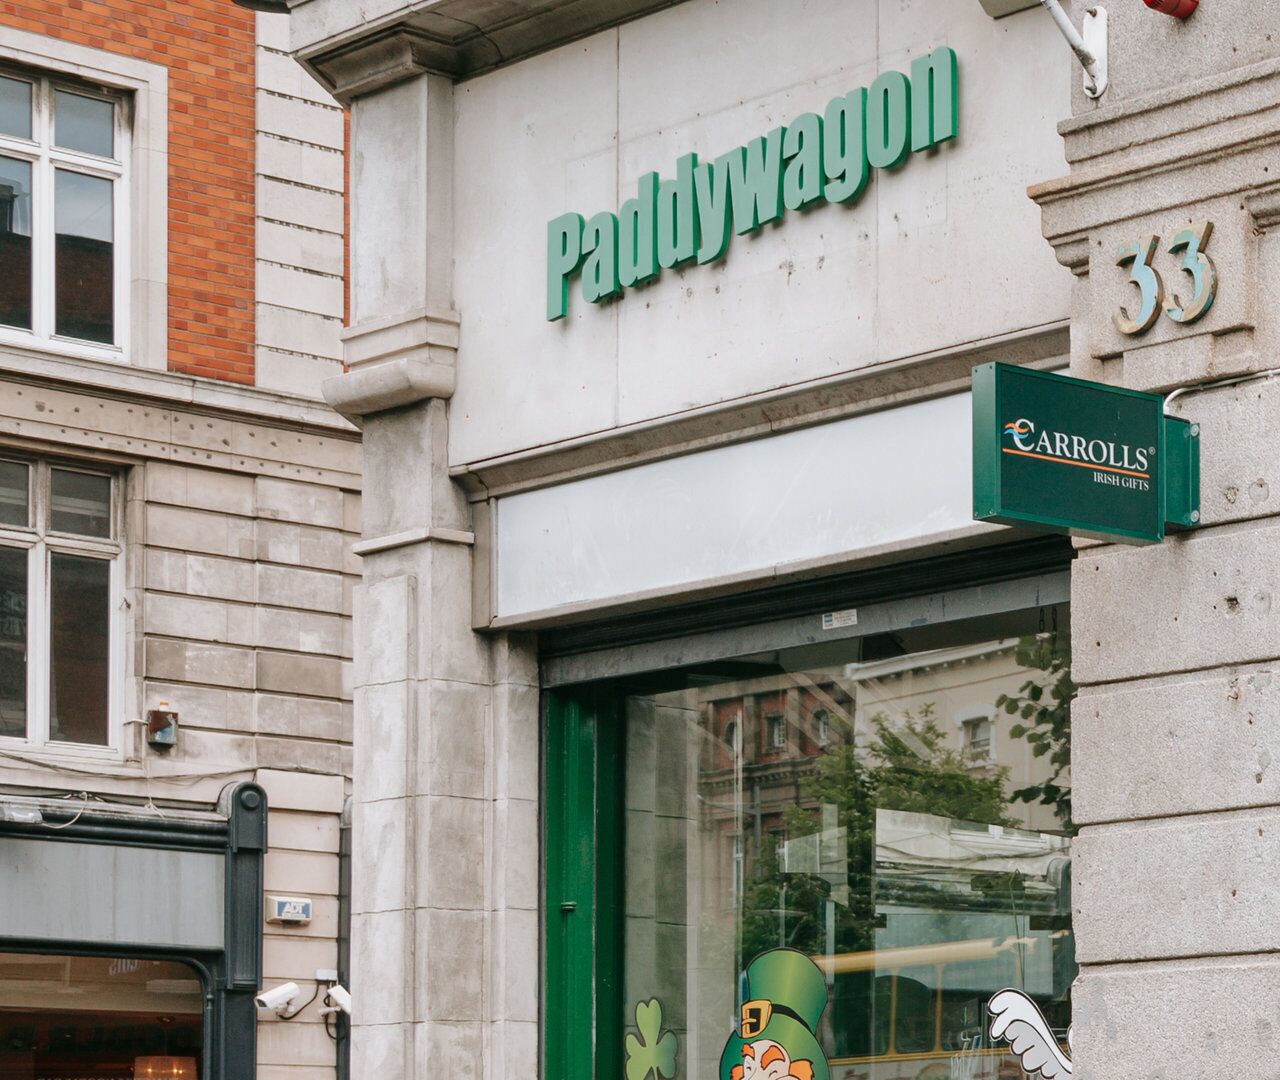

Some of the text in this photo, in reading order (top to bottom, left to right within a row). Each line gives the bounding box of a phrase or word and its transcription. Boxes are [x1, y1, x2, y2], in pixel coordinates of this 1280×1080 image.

[547, 45, 958, 322] Paddywagon
[1112, 221, 1217, 335] 33
[1005, 418, 1149, 471] CARROLLS
[1093, 471, 1149, 491] IRISH GIFTS
[282, 902, 305, 914] ADT
